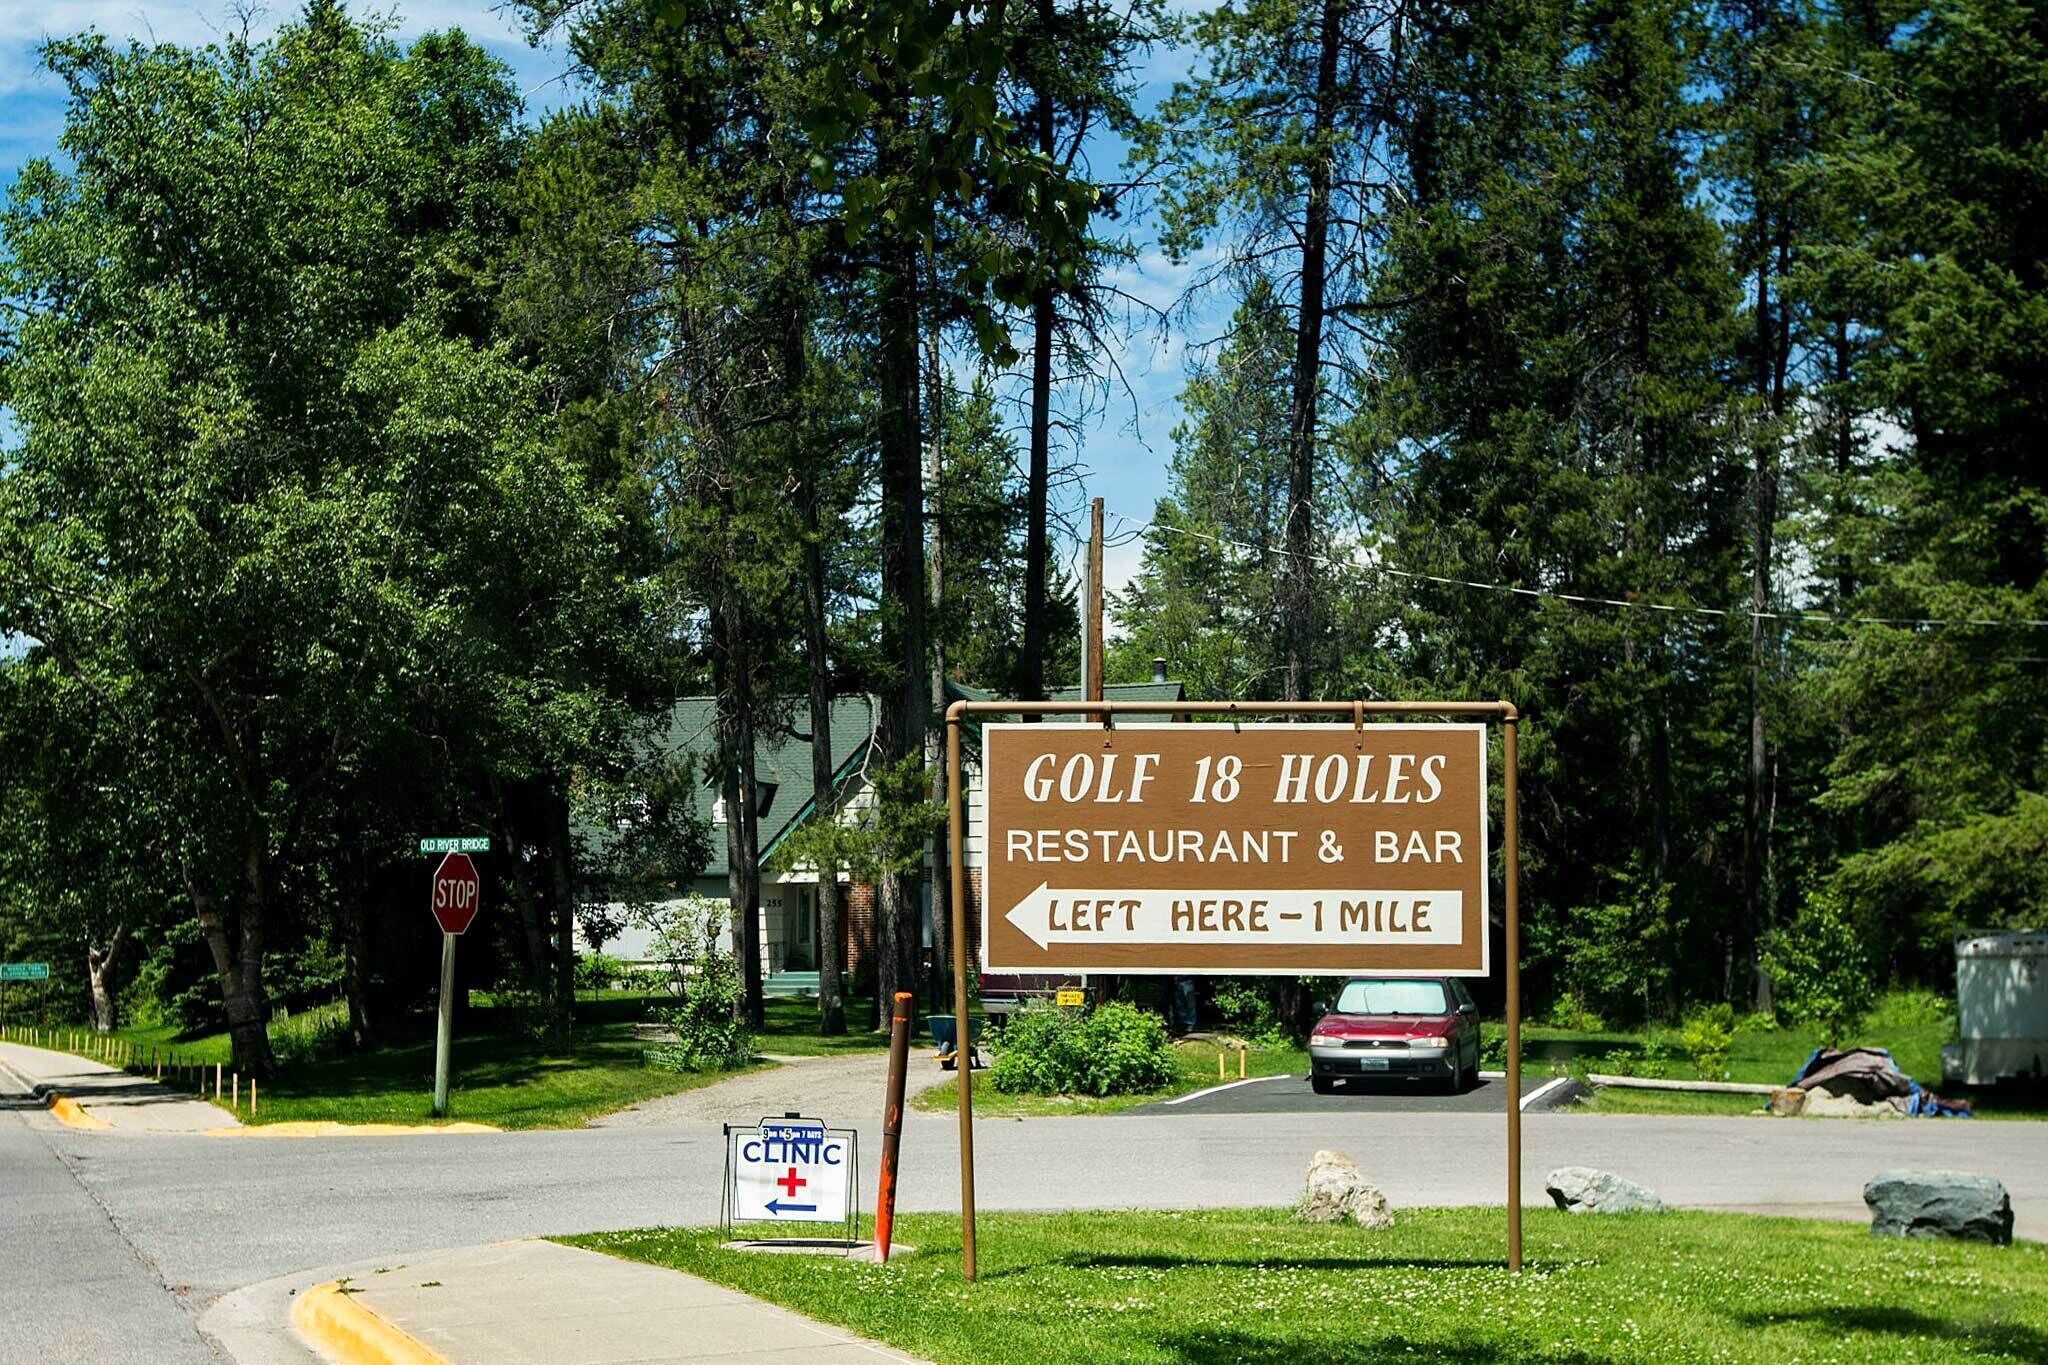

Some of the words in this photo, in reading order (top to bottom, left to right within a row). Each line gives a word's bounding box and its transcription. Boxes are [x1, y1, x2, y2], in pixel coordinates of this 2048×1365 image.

[1023, 753, 1161, 803] GOLF
[1188, 754, 1243, 804] 18
[1273, 753, 1447, 804] HOLES
[421, 839, 435, 851] OLD
[437, 839, 459, 851] RIVER
[462, 838, 489, 850] BRIDGE
[1007, 829, 1299, 863] RESTAURANT
[1317, 829, 1345, 864] &
[1374, 830, 1464, 864] BAR
[436, 878, 476, 909] STOP
[766, 899, 783, 908] 255
[1049, 899, 1142, 932] LEFT
[1171, 900, 1269, 932] HERE
[1340, 900, 1433, 933] MILE
[807, 1130, 823, 1139] DAYS
[742, 1141, 842, 1165] CLINIC
